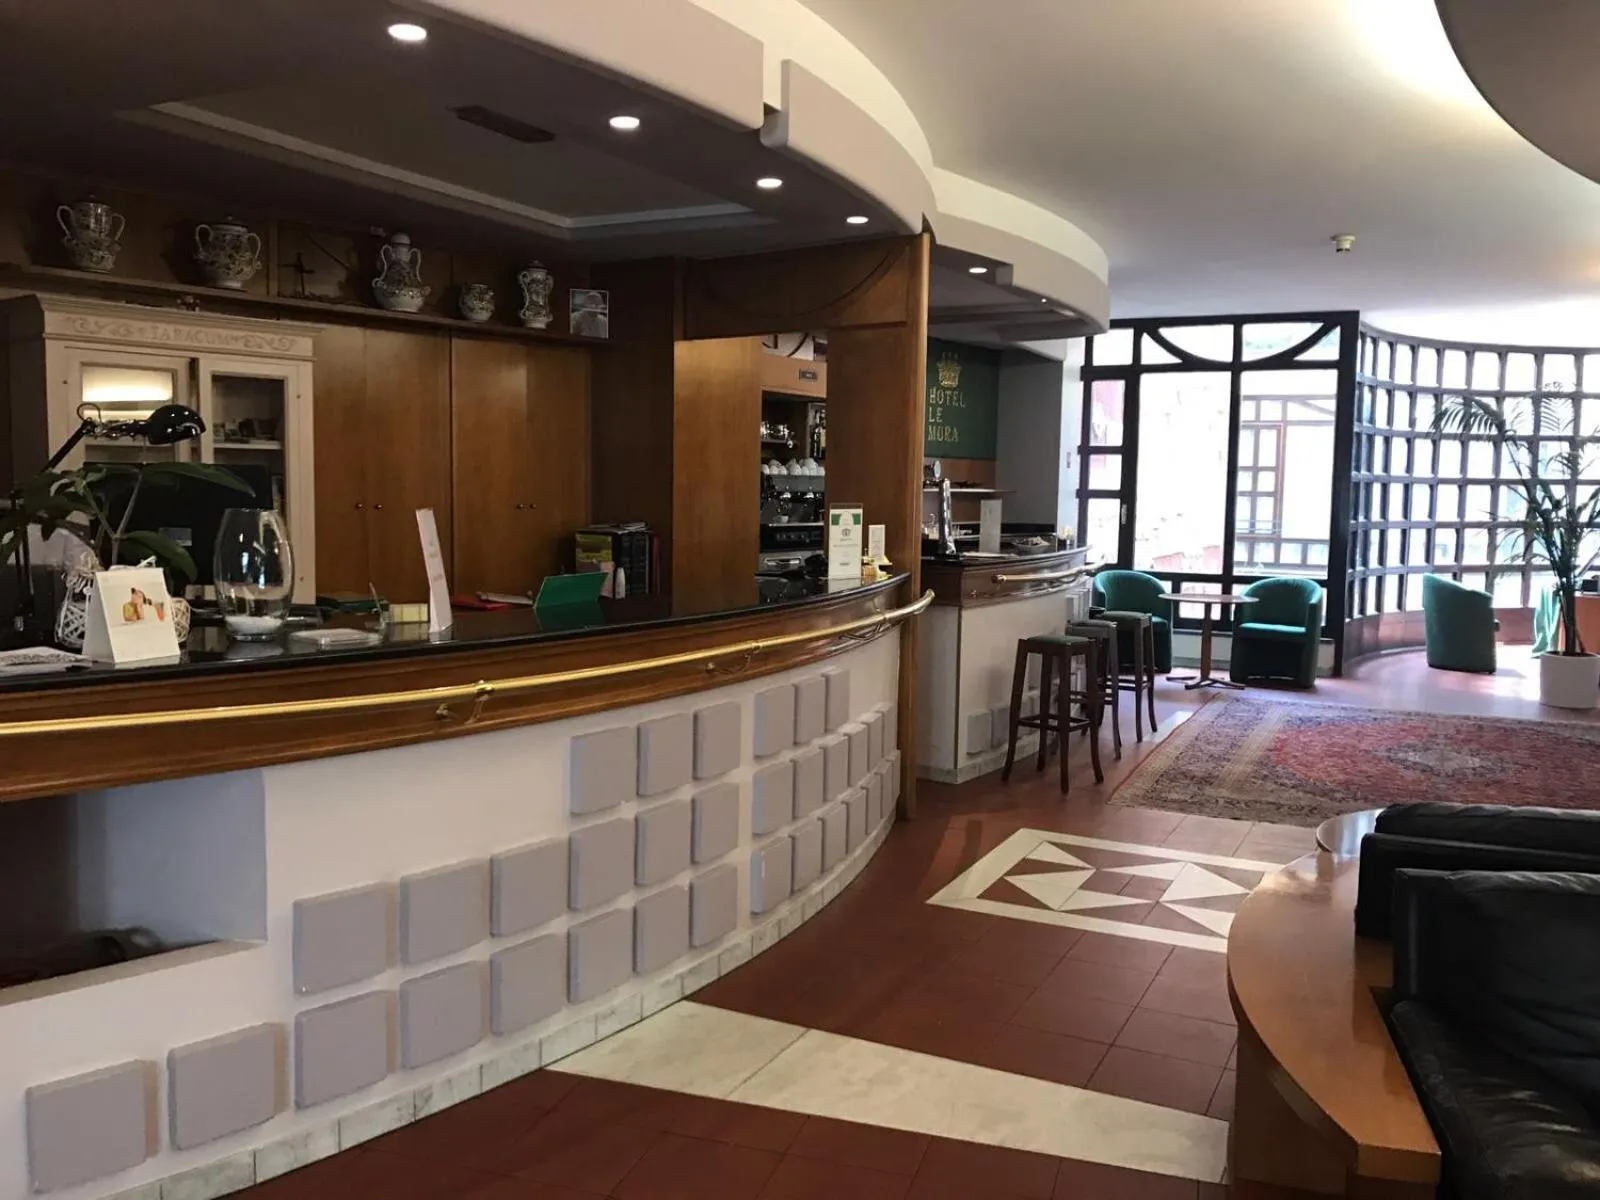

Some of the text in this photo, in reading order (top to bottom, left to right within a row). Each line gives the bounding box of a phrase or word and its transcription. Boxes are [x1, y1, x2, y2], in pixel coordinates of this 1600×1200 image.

[929, 387, 966, 408] HOTEL
[928, 407, 944, 423] LE
[928, 425, 959, 443] MORA
